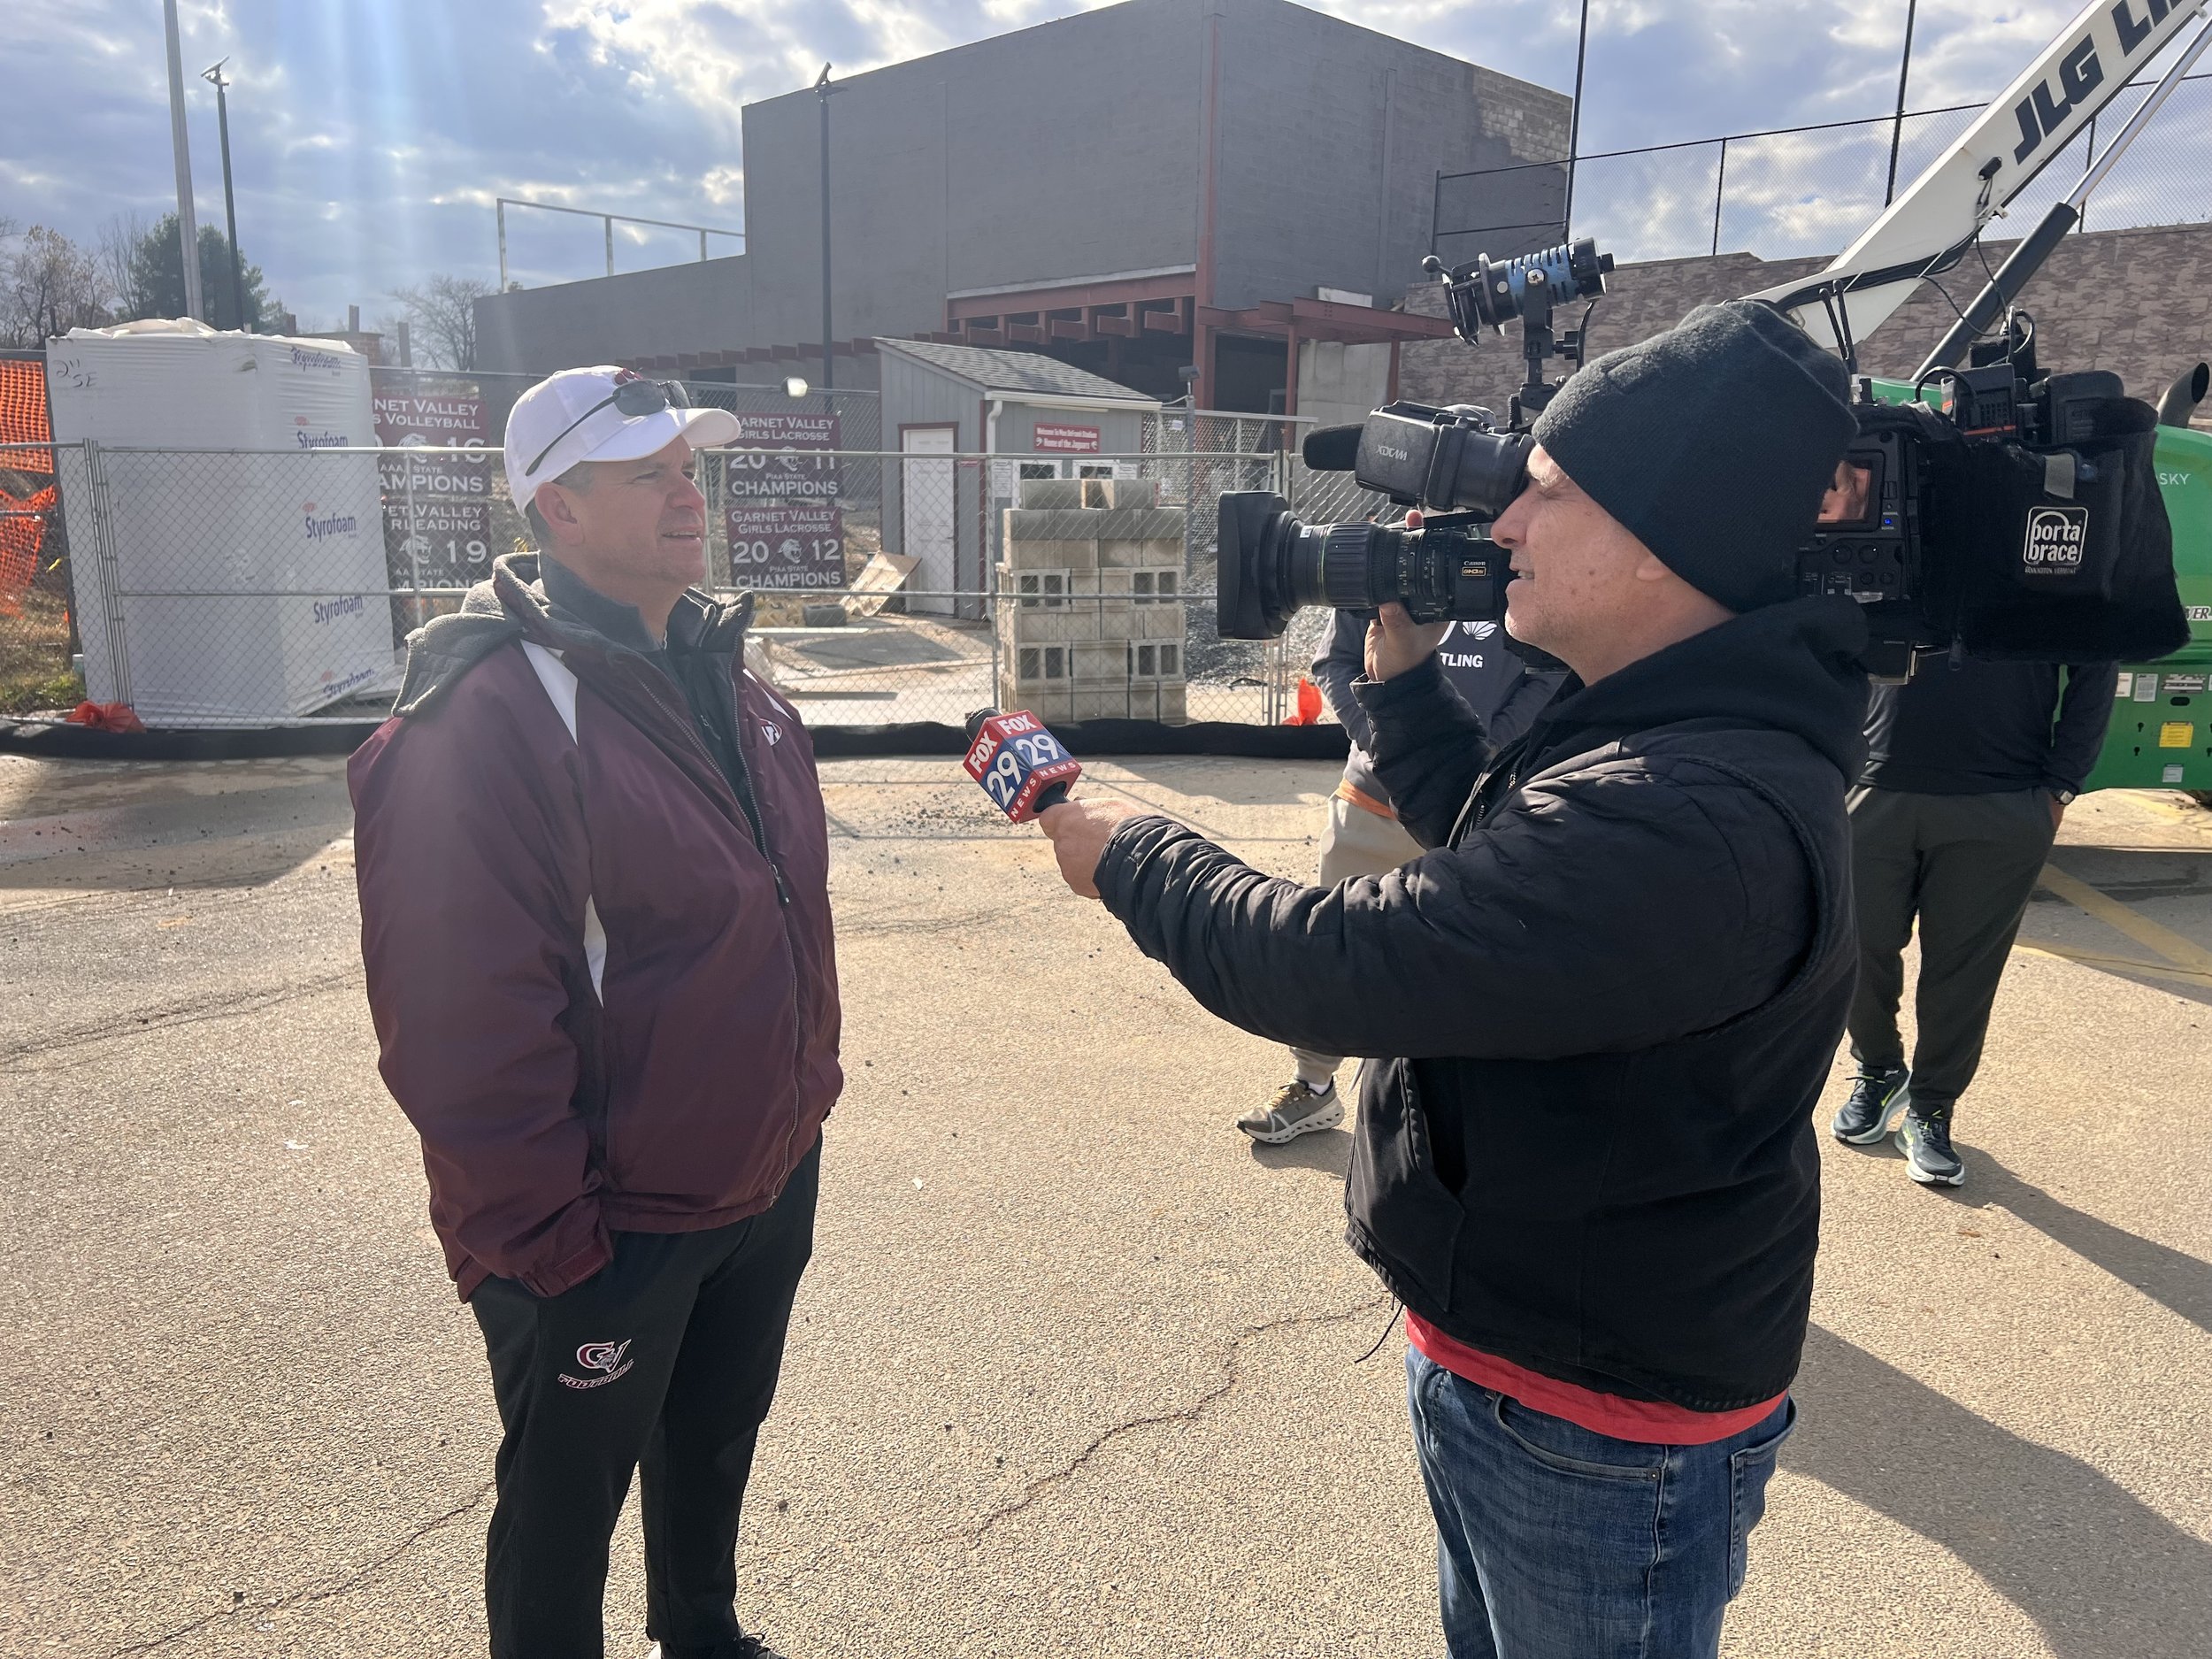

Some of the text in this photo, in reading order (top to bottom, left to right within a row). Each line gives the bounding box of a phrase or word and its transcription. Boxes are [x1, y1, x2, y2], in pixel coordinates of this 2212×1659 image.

[2014, 0, 2182, 165] JLG LI
[374, 398, 479, 417] NET VALLEY
[385, 412, 480, 430] VOLLEYBALL
[741, 417, 834, 430] ARNET VALLEY
[772, 429, 831, 442] LACROSSE
[730, 446, 835, 470] 20 11
[1376, 444, 1408, 461] XDCAM
[412, 464, 443, 474] STATE
[380, 473, 484, 493] AMPIONS
[732, 480, 839, 495] CHAMPIONS
[2158, 472, 2191, 486] SKY
[415, 504, 482, 518] VALLEY
[731, 510, 835, 523] GARNET VALLEY
[305, 512, 356, 542] Styrofoam
[391, 518, 481, 531] RLEADING
[738, 522, 832, 534] GIRLS LACROSSE
[2031, 517, 2081, 541] porta
[446, 539, 488, 564] 19
[733, 538, 841, 565] 20 12
[2028, 543, 2078, 562] brace
[736, 571, 841, 588] CHAMPIONS
[313, 594, 363, 626] Styrofoam
[1440, 652, 1484, 669] TLING
[997, 714, 1037, 735] FOX
[968, 731, 998, 774] FOX
[1015, 733, 1059, 766] 29
[987, 750, 1022, 807] 29
[1039, 762, 1076, 777] NEWS
[1010, 778, 1037, 818] NEWS
